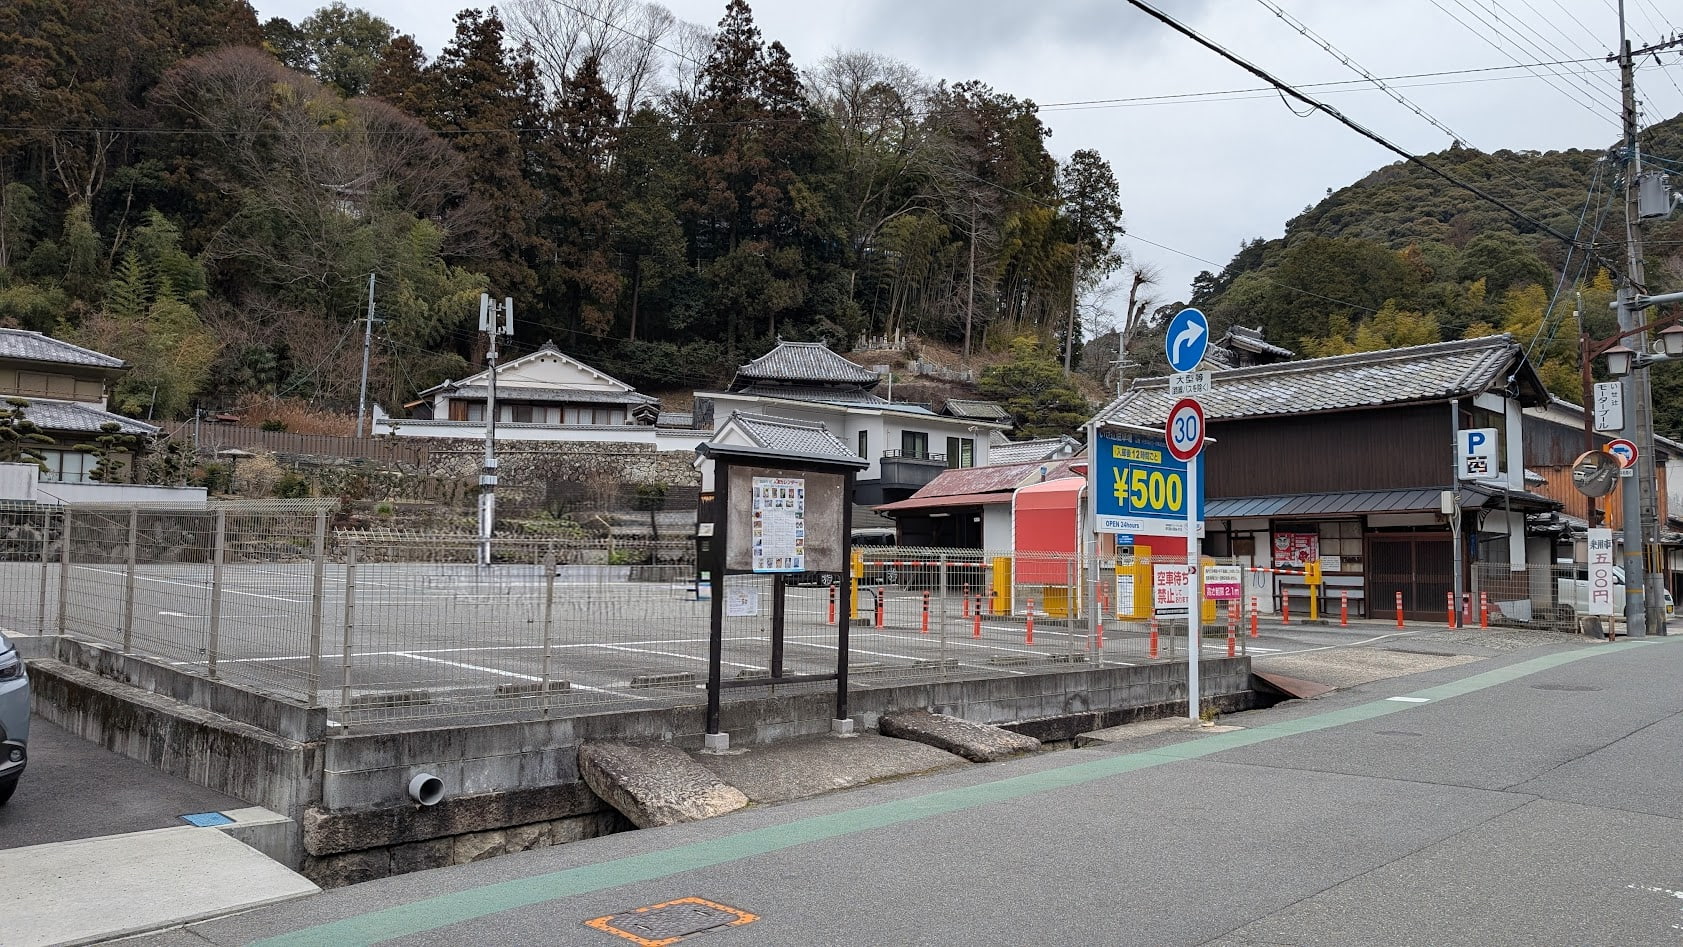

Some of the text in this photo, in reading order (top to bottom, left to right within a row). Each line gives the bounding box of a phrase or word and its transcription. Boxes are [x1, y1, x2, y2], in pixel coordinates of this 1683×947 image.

[1610, 383, 1619, 407] いせ辻
[1597, 384, 1609, 430] モータープール
[1174, 415, 1197, 444] 30
[1468, 432, 1486, 455] P
[1113, 466, 1183, 512] ¥500
[1105, 520, 1140, 529] OPEN 24hours
[1157, 570, 1189, 586] 空車待ち
[1157, 588, 1175, 604] 禁止
